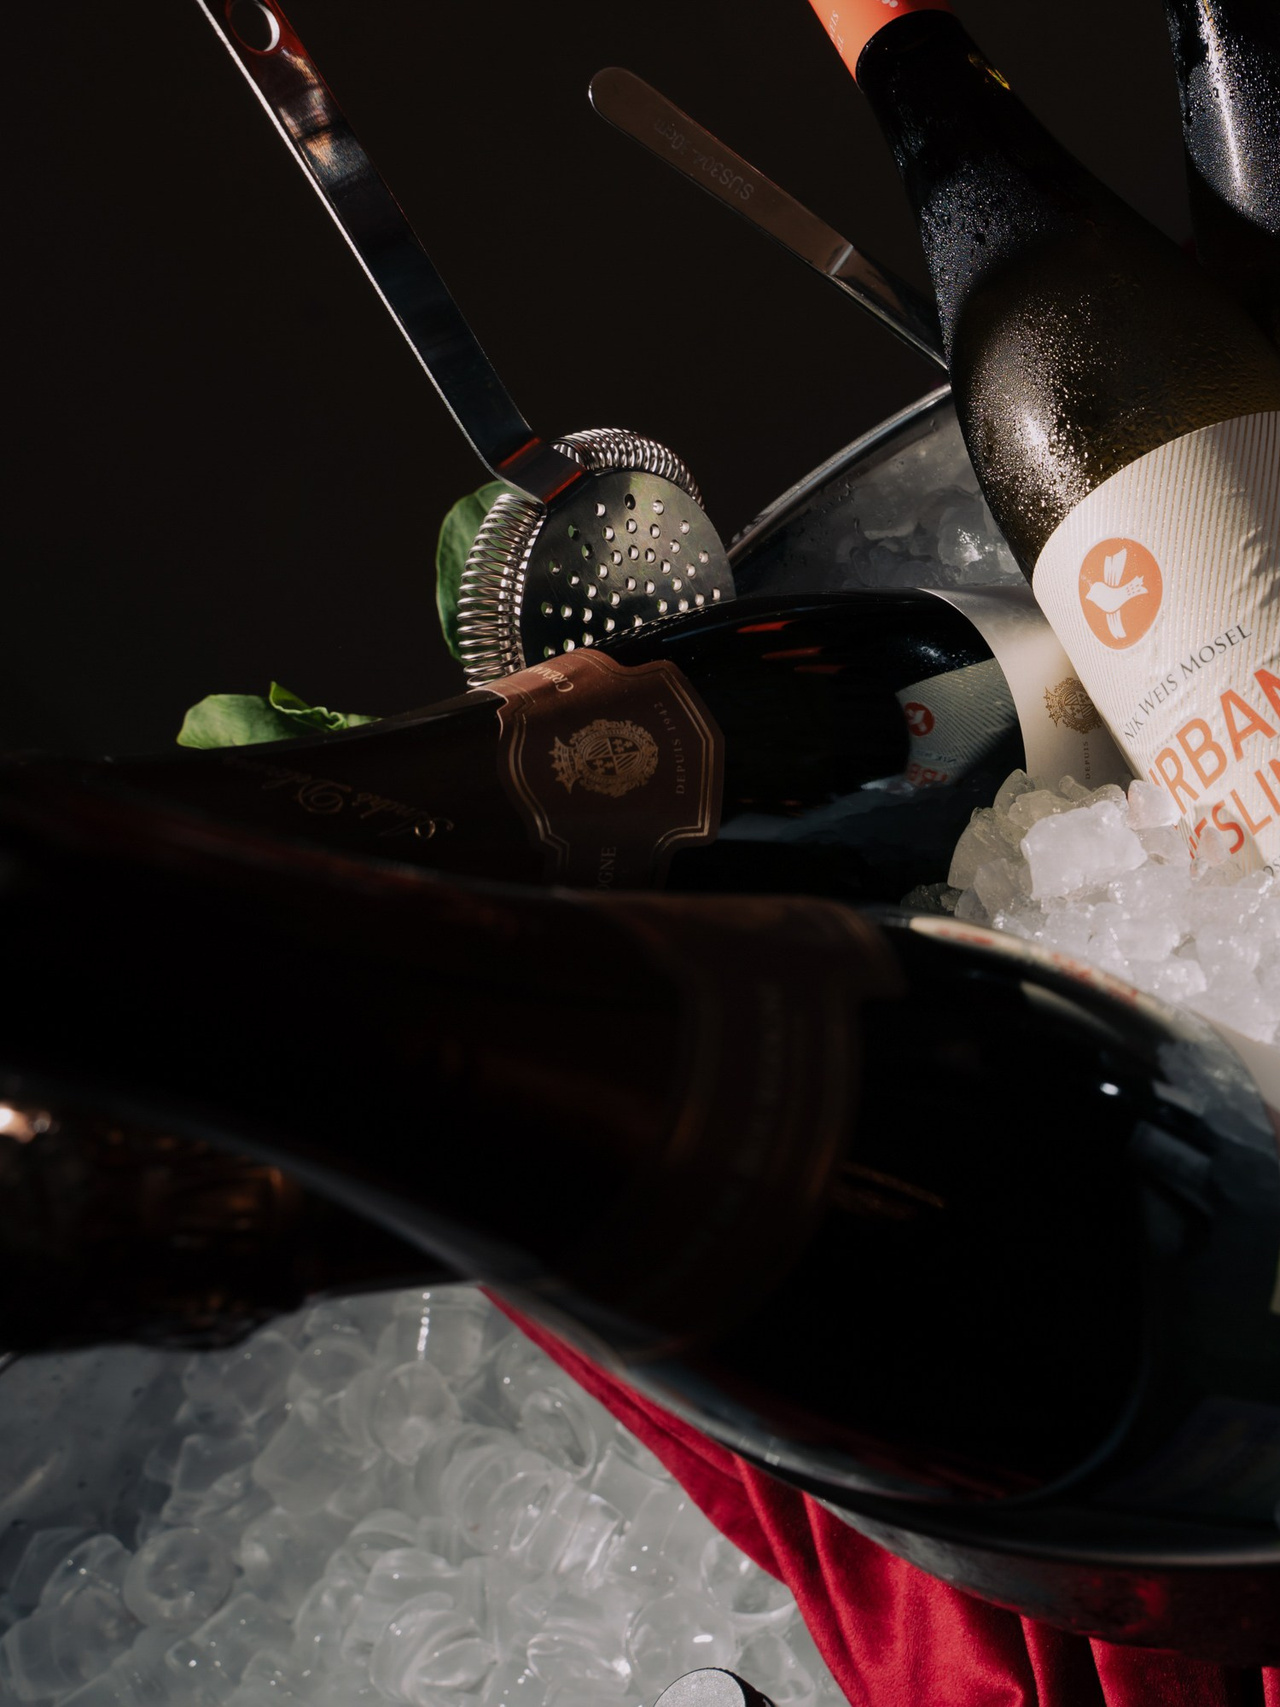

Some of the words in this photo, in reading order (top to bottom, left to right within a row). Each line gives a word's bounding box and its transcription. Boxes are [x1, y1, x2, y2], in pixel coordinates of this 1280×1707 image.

[1123, 717, 1146, 744] NIK
[1143, 672, 1179, 717] WEIS
[1180, 624, 1252, 681] MOSEL
[654, 702, 677, 732] 1942
[672, 738, 685, 795] DEPUIS
[1082, 741, 1092, 780] DEPUIS
